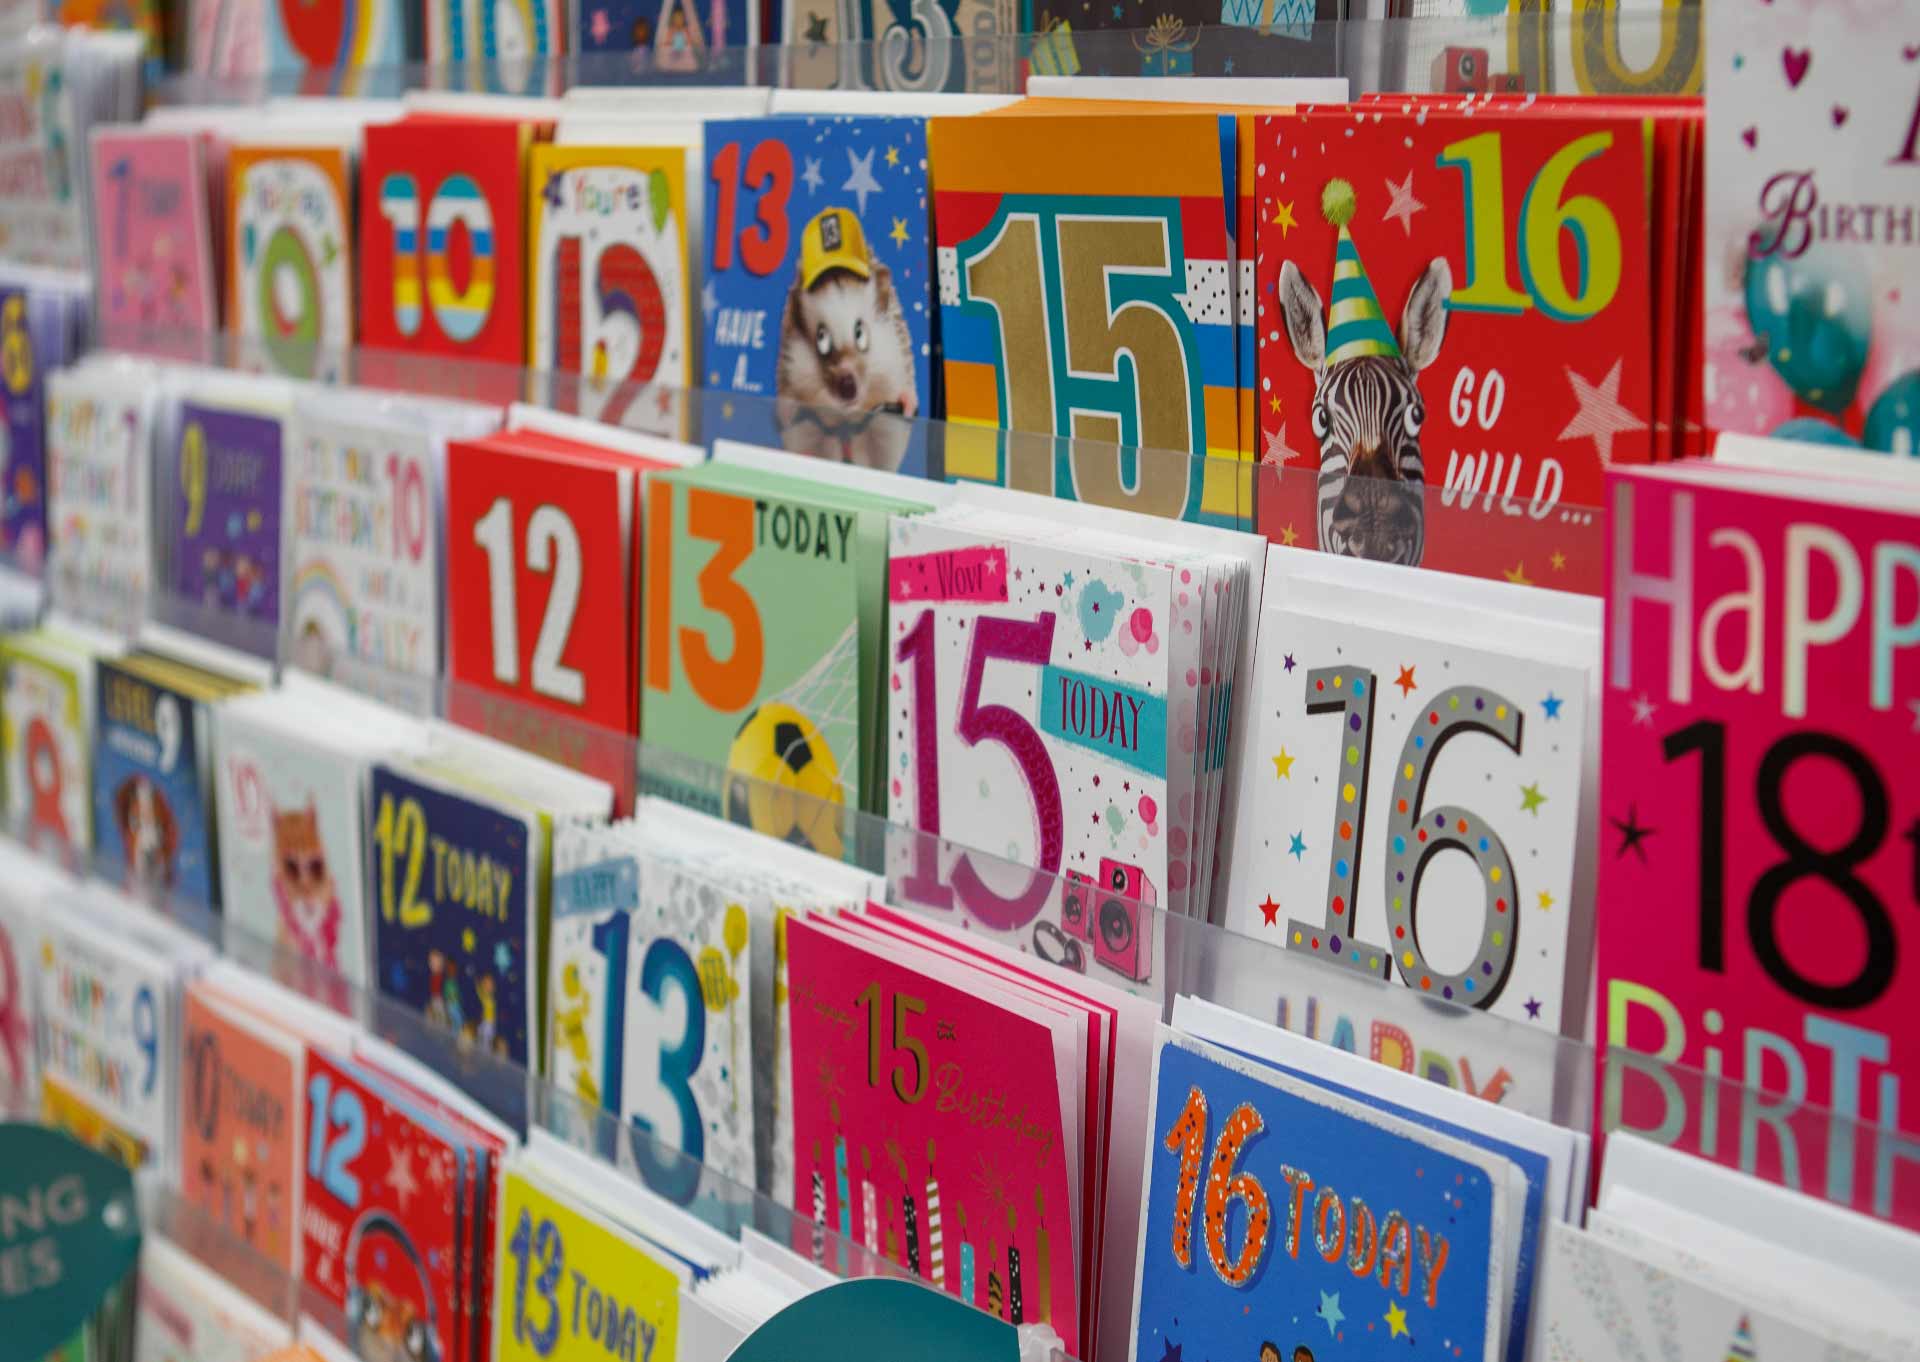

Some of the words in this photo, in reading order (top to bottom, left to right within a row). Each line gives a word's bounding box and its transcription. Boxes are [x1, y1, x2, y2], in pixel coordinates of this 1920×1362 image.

[379, 172, 496, 343] 10
[711, 138, 793, 277] 13
[1436, 131, 1622, 322] 16
[1748, 168, 1920, 260] BIRTH
[552, 235, 667, 428] 12
[715, 309, 766, 349] HAVE
[965, 212, 1195, 522] 15
[1448, 365, 1505, 430] GO
[181, 420, 207, 538] 9
[385, 452, 428, 568] 10
[1441, 449, 1593, 527] WILD...
[474, 496, 586, 706] 12
[645, 478, 764, 715] 13
[755, 501, 855, 563] TODAY
[155, 695, 182, 773] 9
[894, 608, 1065, 932] 15
[1058, 676, 1146, 752] TODAY
[374, 793, 433, 928] 12
[430, 837, 512, 924] TODAY
[1286, 664, 1525, 1018] 16
[1661, 717, 1900, 1012] 18
[133, 984, 159, 1097] 9
[592, 910, 706, 1208] 13
[853, 981, 930, 1104] 15
[308, 1073, 367, 1209] 12
[934, 1062, 1056, 1170] Birthday
[1164, 1085, 1271, 1290] 16
[1280, 1163, 1450, 1310] TODAY
[510, 1207, 564, 1357] 13
[569, 1270, 658, 1362] TODAY
